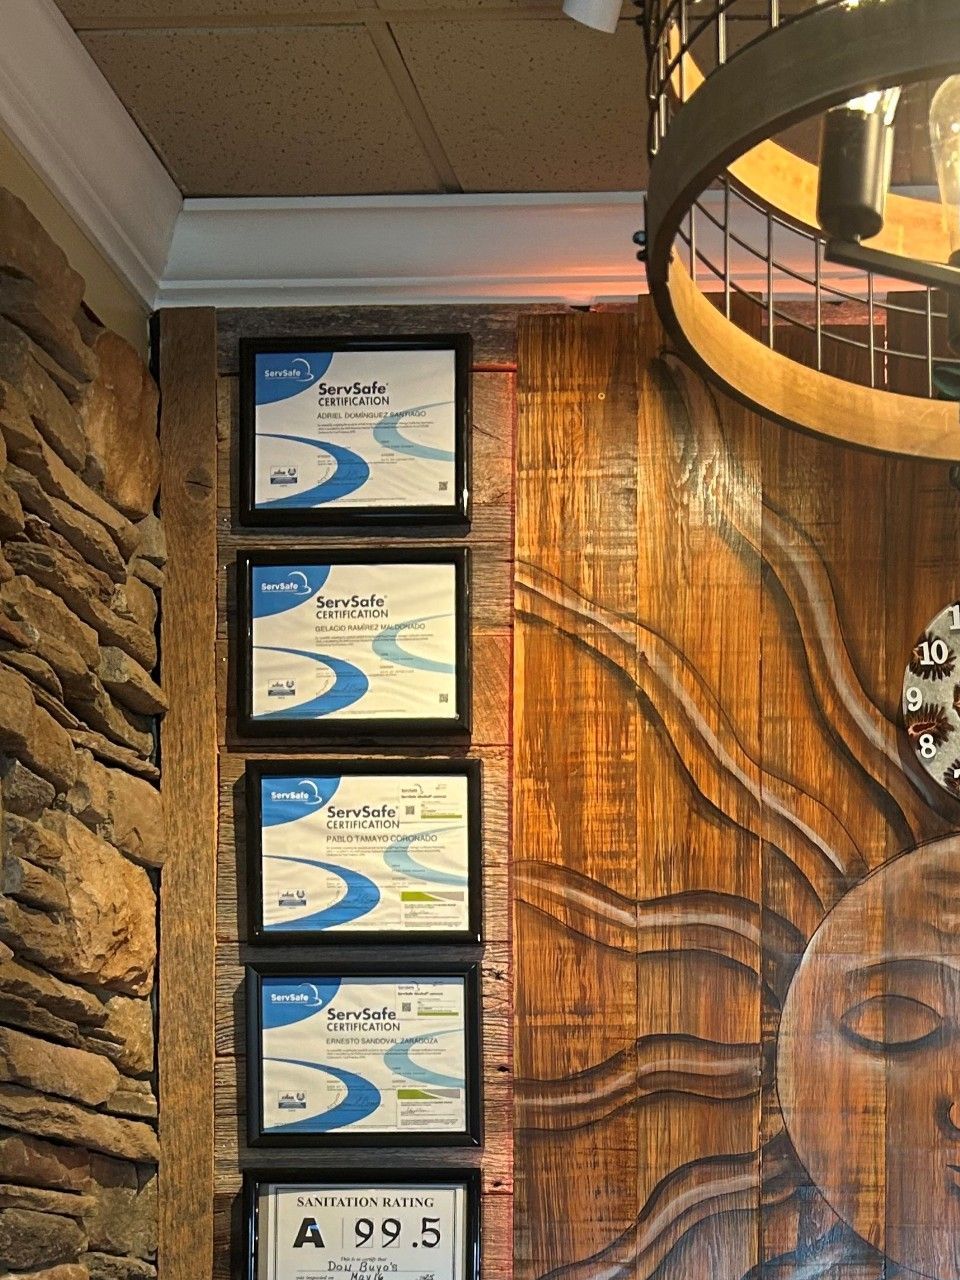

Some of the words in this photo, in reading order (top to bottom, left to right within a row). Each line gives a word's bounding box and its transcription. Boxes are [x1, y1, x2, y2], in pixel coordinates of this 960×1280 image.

[264, 369, 301, 378] ServSafe
[318, 396, 390, 407] CERTIFICATION
[261, 582, 298, 591] ServSafe
[315, 609, 389, 620] CERTIFICATION
[918, 640, 949, 665] 10
[906, 686, 923, 711] 9
[919, 733, 936, 758] 8
[271, 791, 309, 800] ServSafe
[326, 820, 400, 830] CERTIFICATION
[326, 835, 354, 843] PABLO
[355, 835, 389, 843] TAMAYO
[271, 993, 309, 1002] ServSafe
[327, 1007, 396, 1021] ServSafe
[327, 1022, 400, 1032] CERTIFICATION
[296, 1197, 379, 1208] SANITATION
[382, 1197, 434, 1208] RATING
[292, 1217, 325, 1248] A
